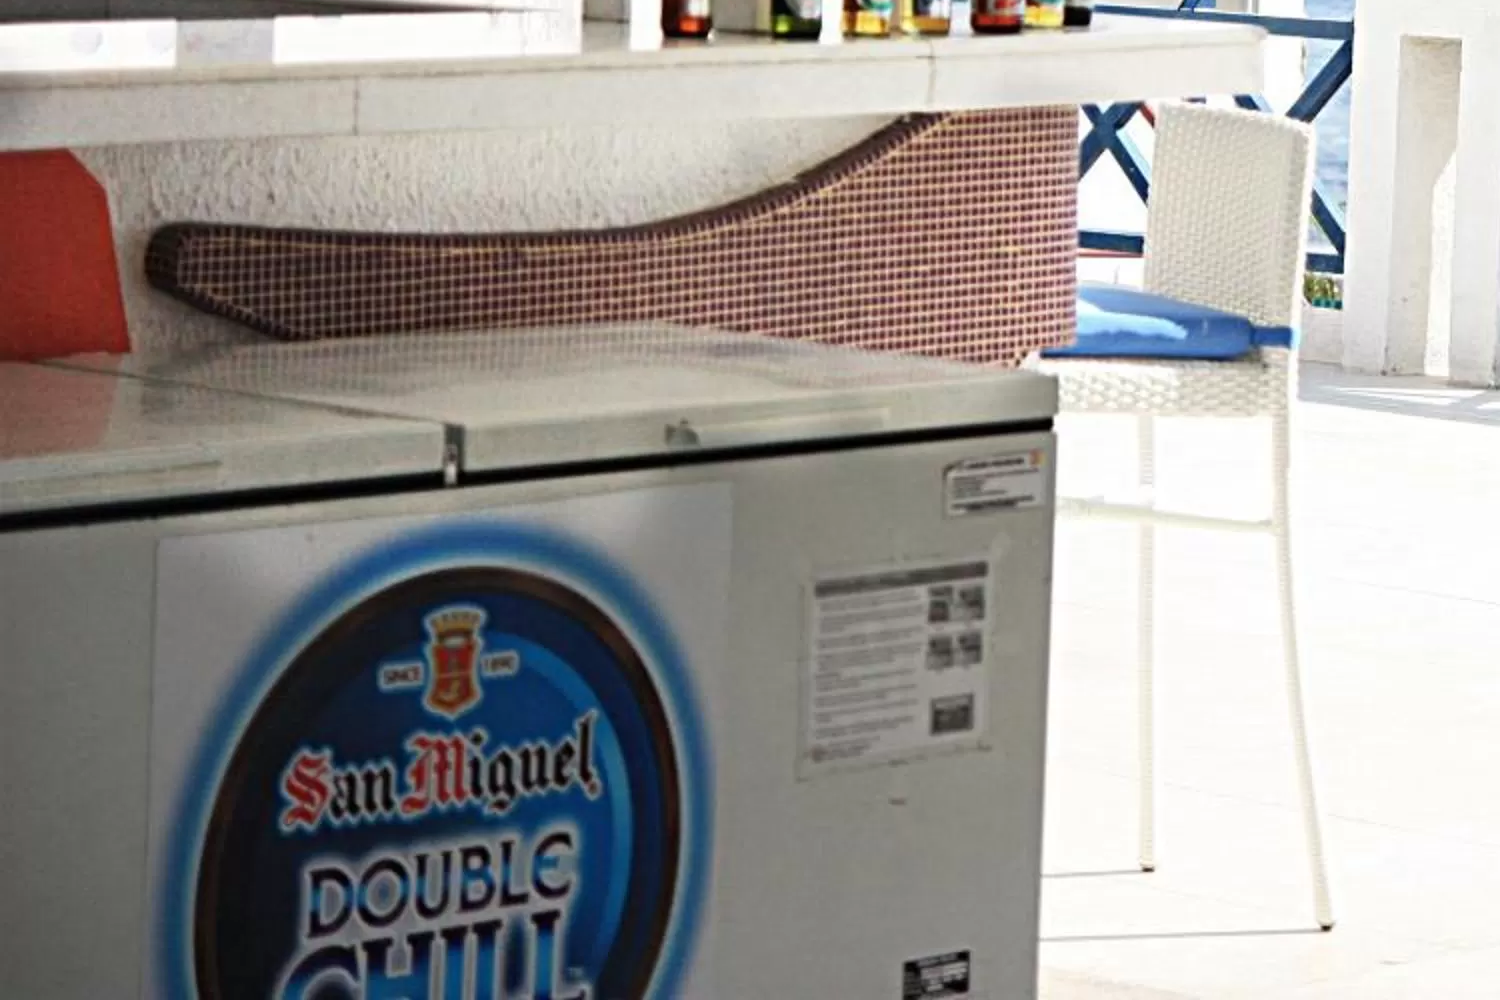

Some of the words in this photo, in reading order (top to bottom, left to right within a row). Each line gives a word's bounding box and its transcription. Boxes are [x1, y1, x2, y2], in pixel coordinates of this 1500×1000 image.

[283, 751, 396, 828] San
[401, 713, 600, 812] Miguel
[307, 832, 574, 938] DOUBLE
